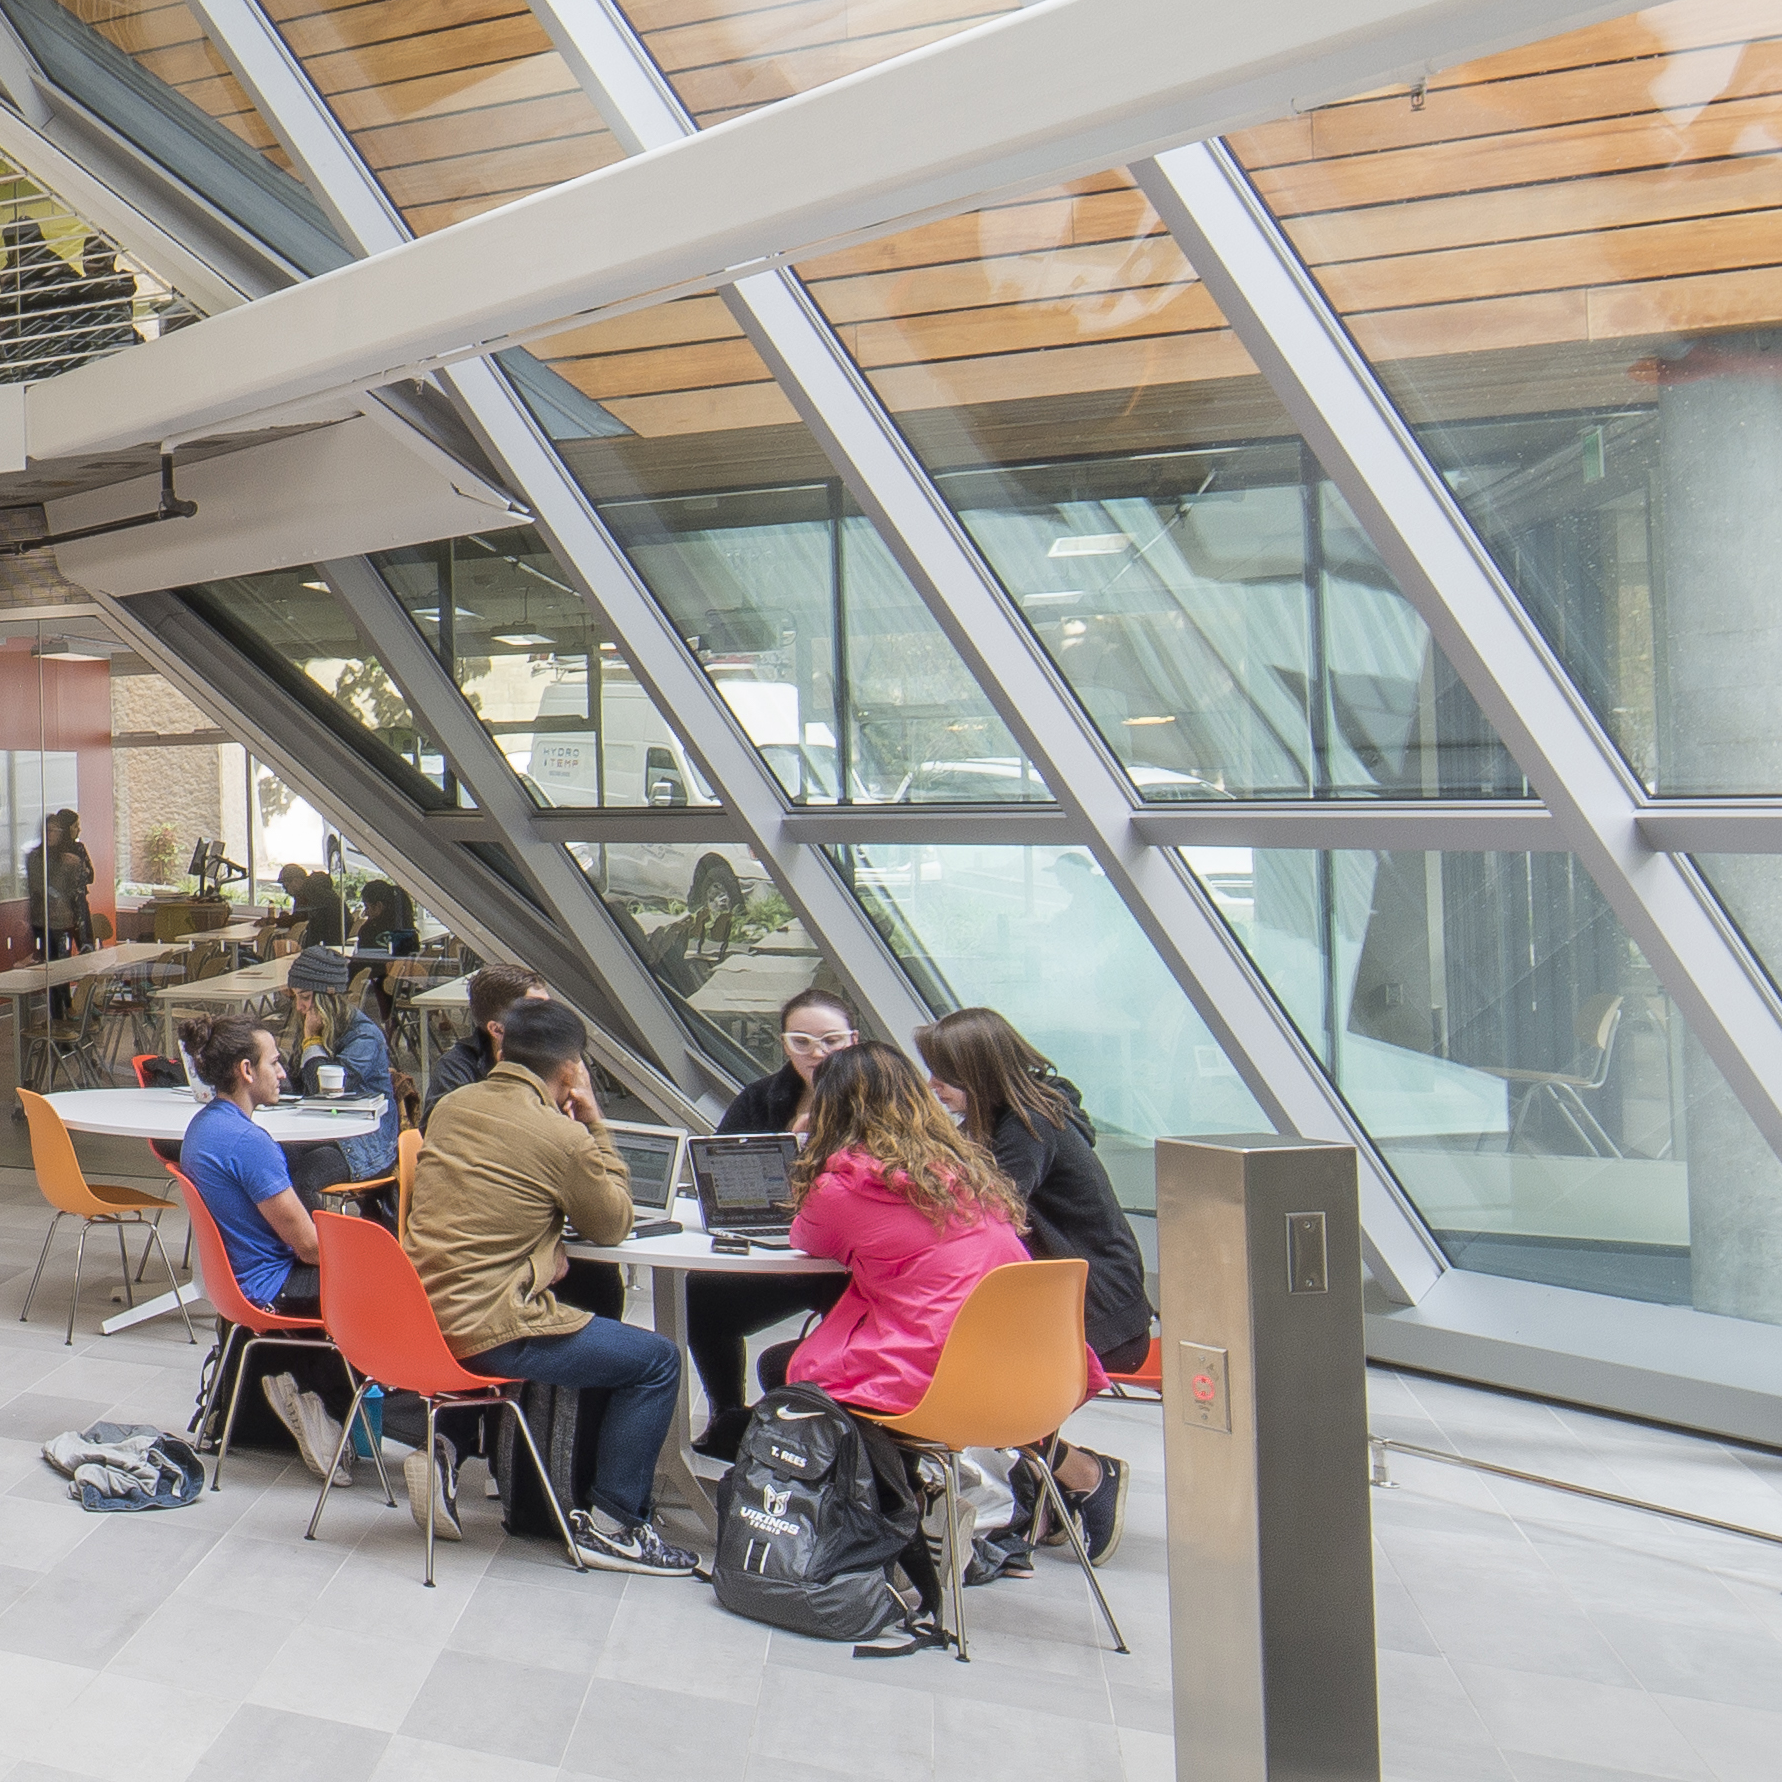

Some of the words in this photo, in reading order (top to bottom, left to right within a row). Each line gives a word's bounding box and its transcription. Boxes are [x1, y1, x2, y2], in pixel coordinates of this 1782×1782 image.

[543, 747, 580, 757] HYDRO
[550, 758, 579, 768] TEMP
[771, 1446, 779, 1457] T.
[781, 1450, 808, 1468] REES
[740, 1506, 800, 1535] VIKINGS
[749, 1520, 781, 1535] TENNIS
